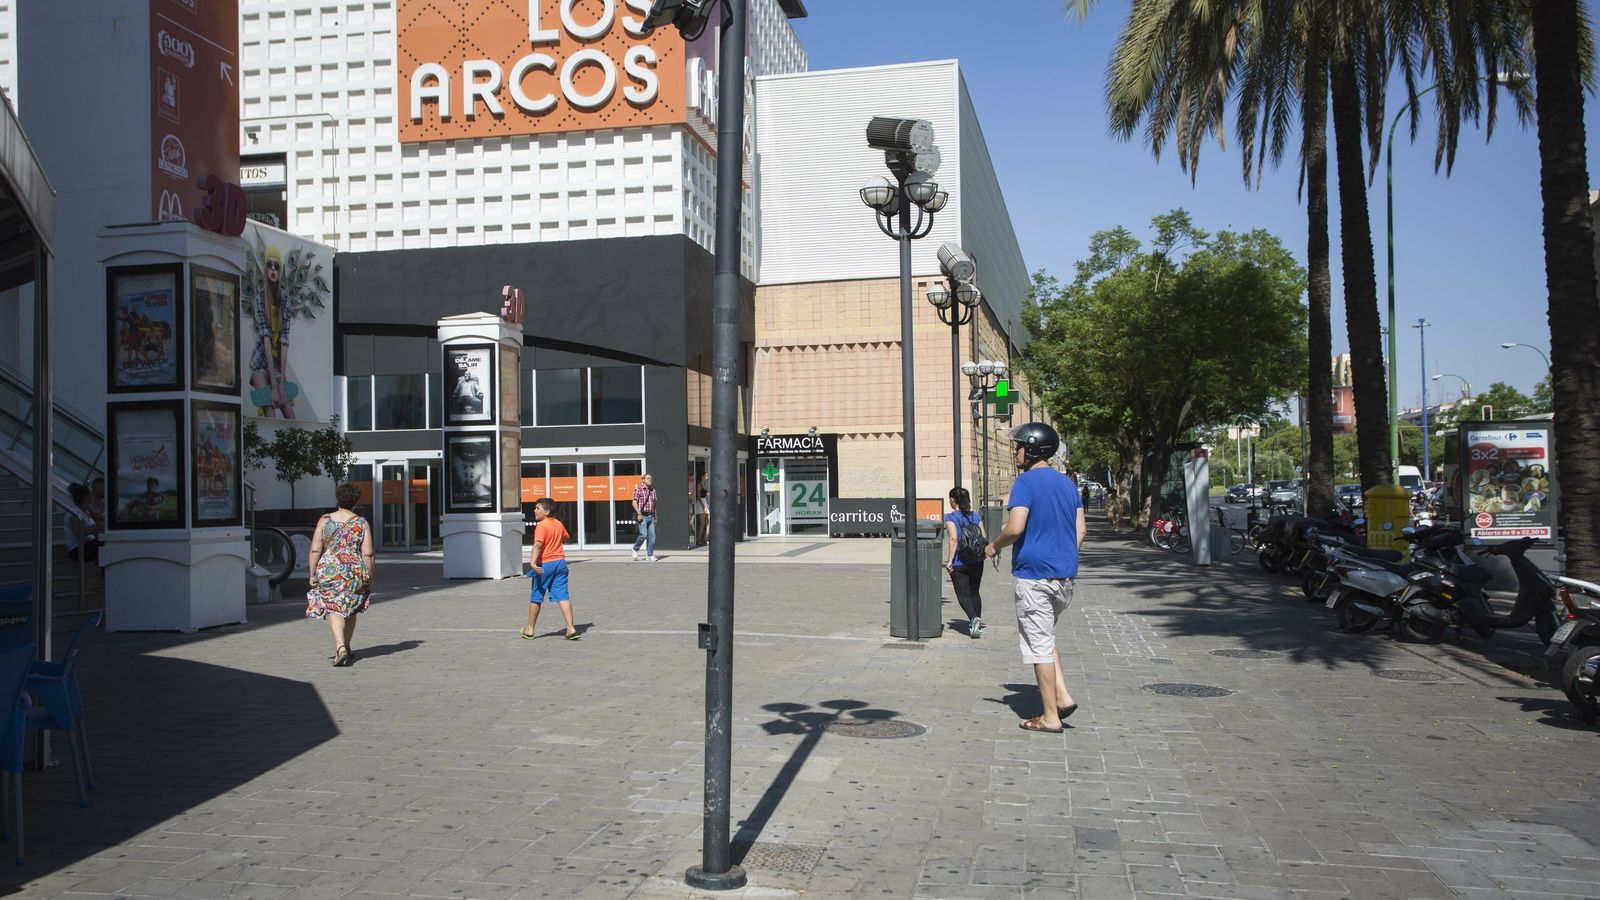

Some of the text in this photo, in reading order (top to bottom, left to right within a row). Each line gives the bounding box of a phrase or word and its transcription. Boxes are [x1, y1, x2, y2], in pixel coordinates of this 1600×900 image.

[410, 45, 659, 120] ARCOS
[194, 175, 247, 237] 3D
[501, 285, 525, 323] 3D
[757, 437, 824, 449] FARMACIA
[1471, 448, 1499, 460] 3x2
[791, 482, 826, 508] 24
[830, 509, 884, 523] carritos
